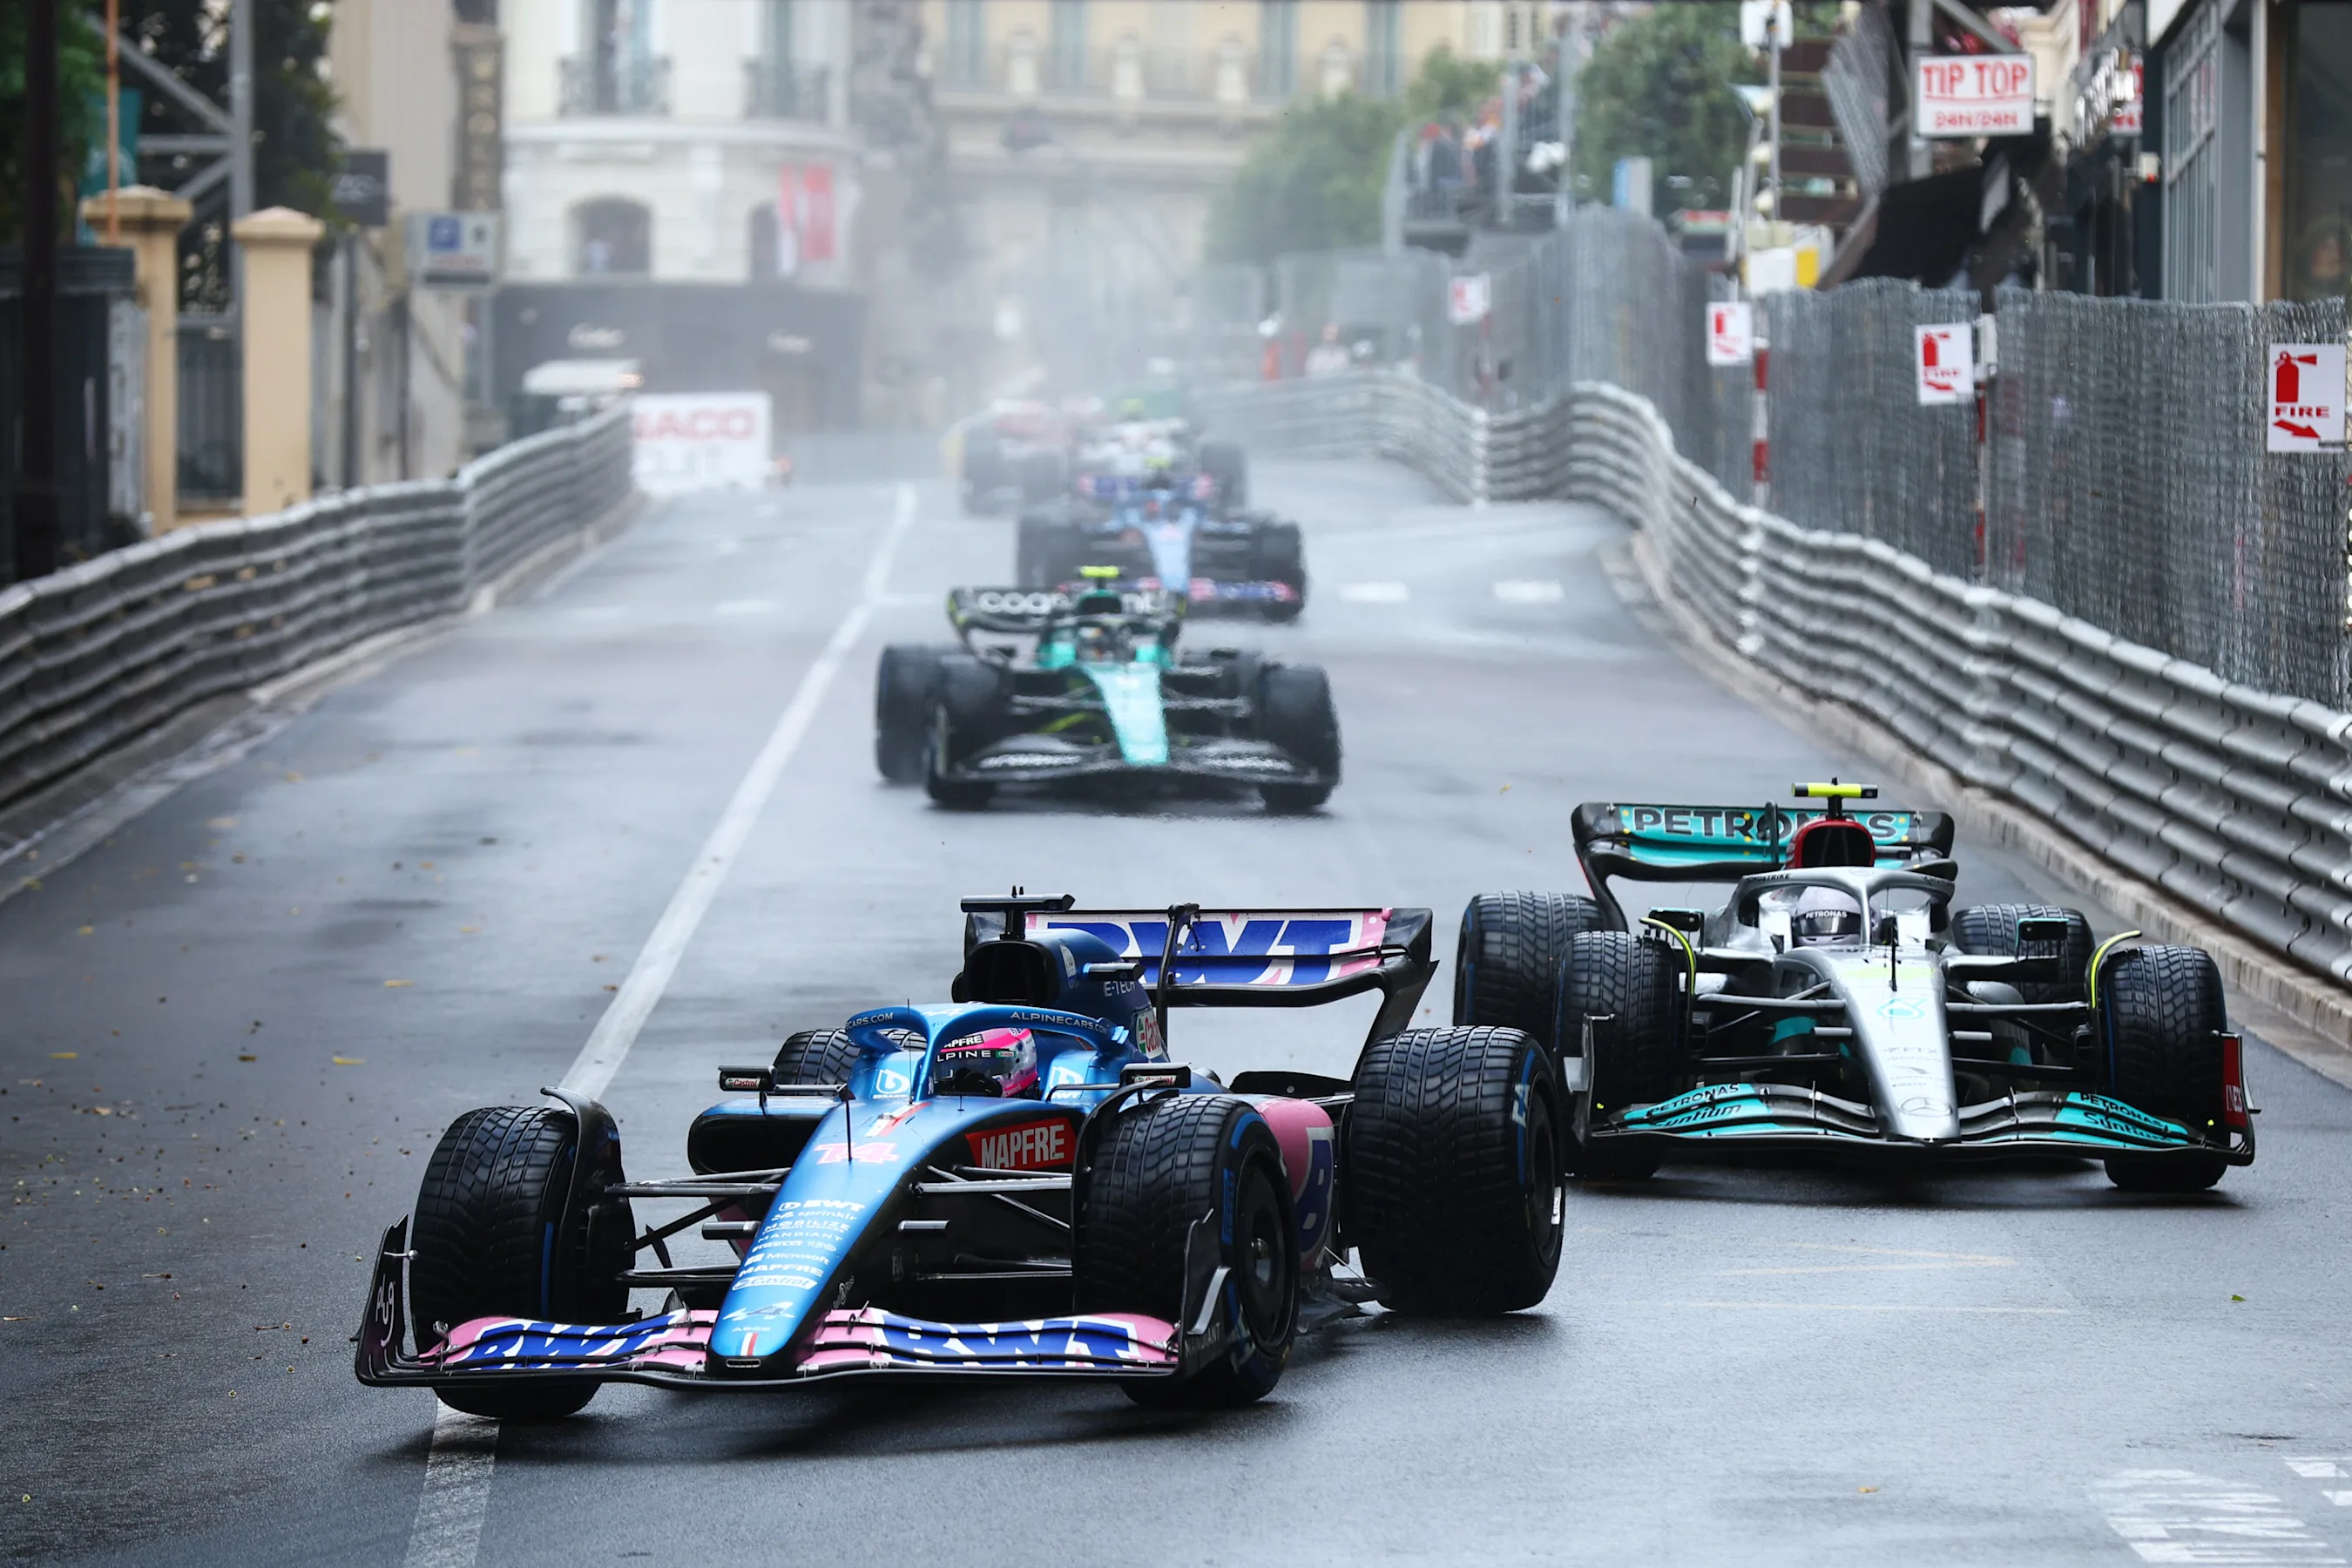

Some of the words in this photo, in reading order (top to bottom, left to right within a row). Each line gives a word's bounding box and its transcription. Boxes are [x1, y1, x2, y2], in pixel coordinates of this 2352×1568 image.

[1922, 64, 1963, 94] TIP
[1975, 63, 2028, 95] TOP
[2275, 406, 2329, 418] FIRE
[1634, 808, 1898, 838] PETROS
[1806, 910, 1848, 919] PETRONAS
[937, 1051, 991, 1062] LPINE
[1646, 1084, 1740, 1117] PETRONAS
[2081, 1092, 2164, 1126] PETRONAS
[982, 1125, 1064, 1169] MAPFRE
[814, 1143, 900, 1165] 14
[803, 1200, 866, 1212] BWT
[798, 1211, 857, 1220] sprinklr
[765, 1220, 851, 1232] MOBILIZE
[757, 1231, 843, 1243] MANDIANT
[767, 1254, 829, 1265] Microsoft
[738, 1265, 824, 1278] MAPFRE
[752, 1277, 811, 1288] Castrol
[882, 1314, 1132, 1368] BWT
